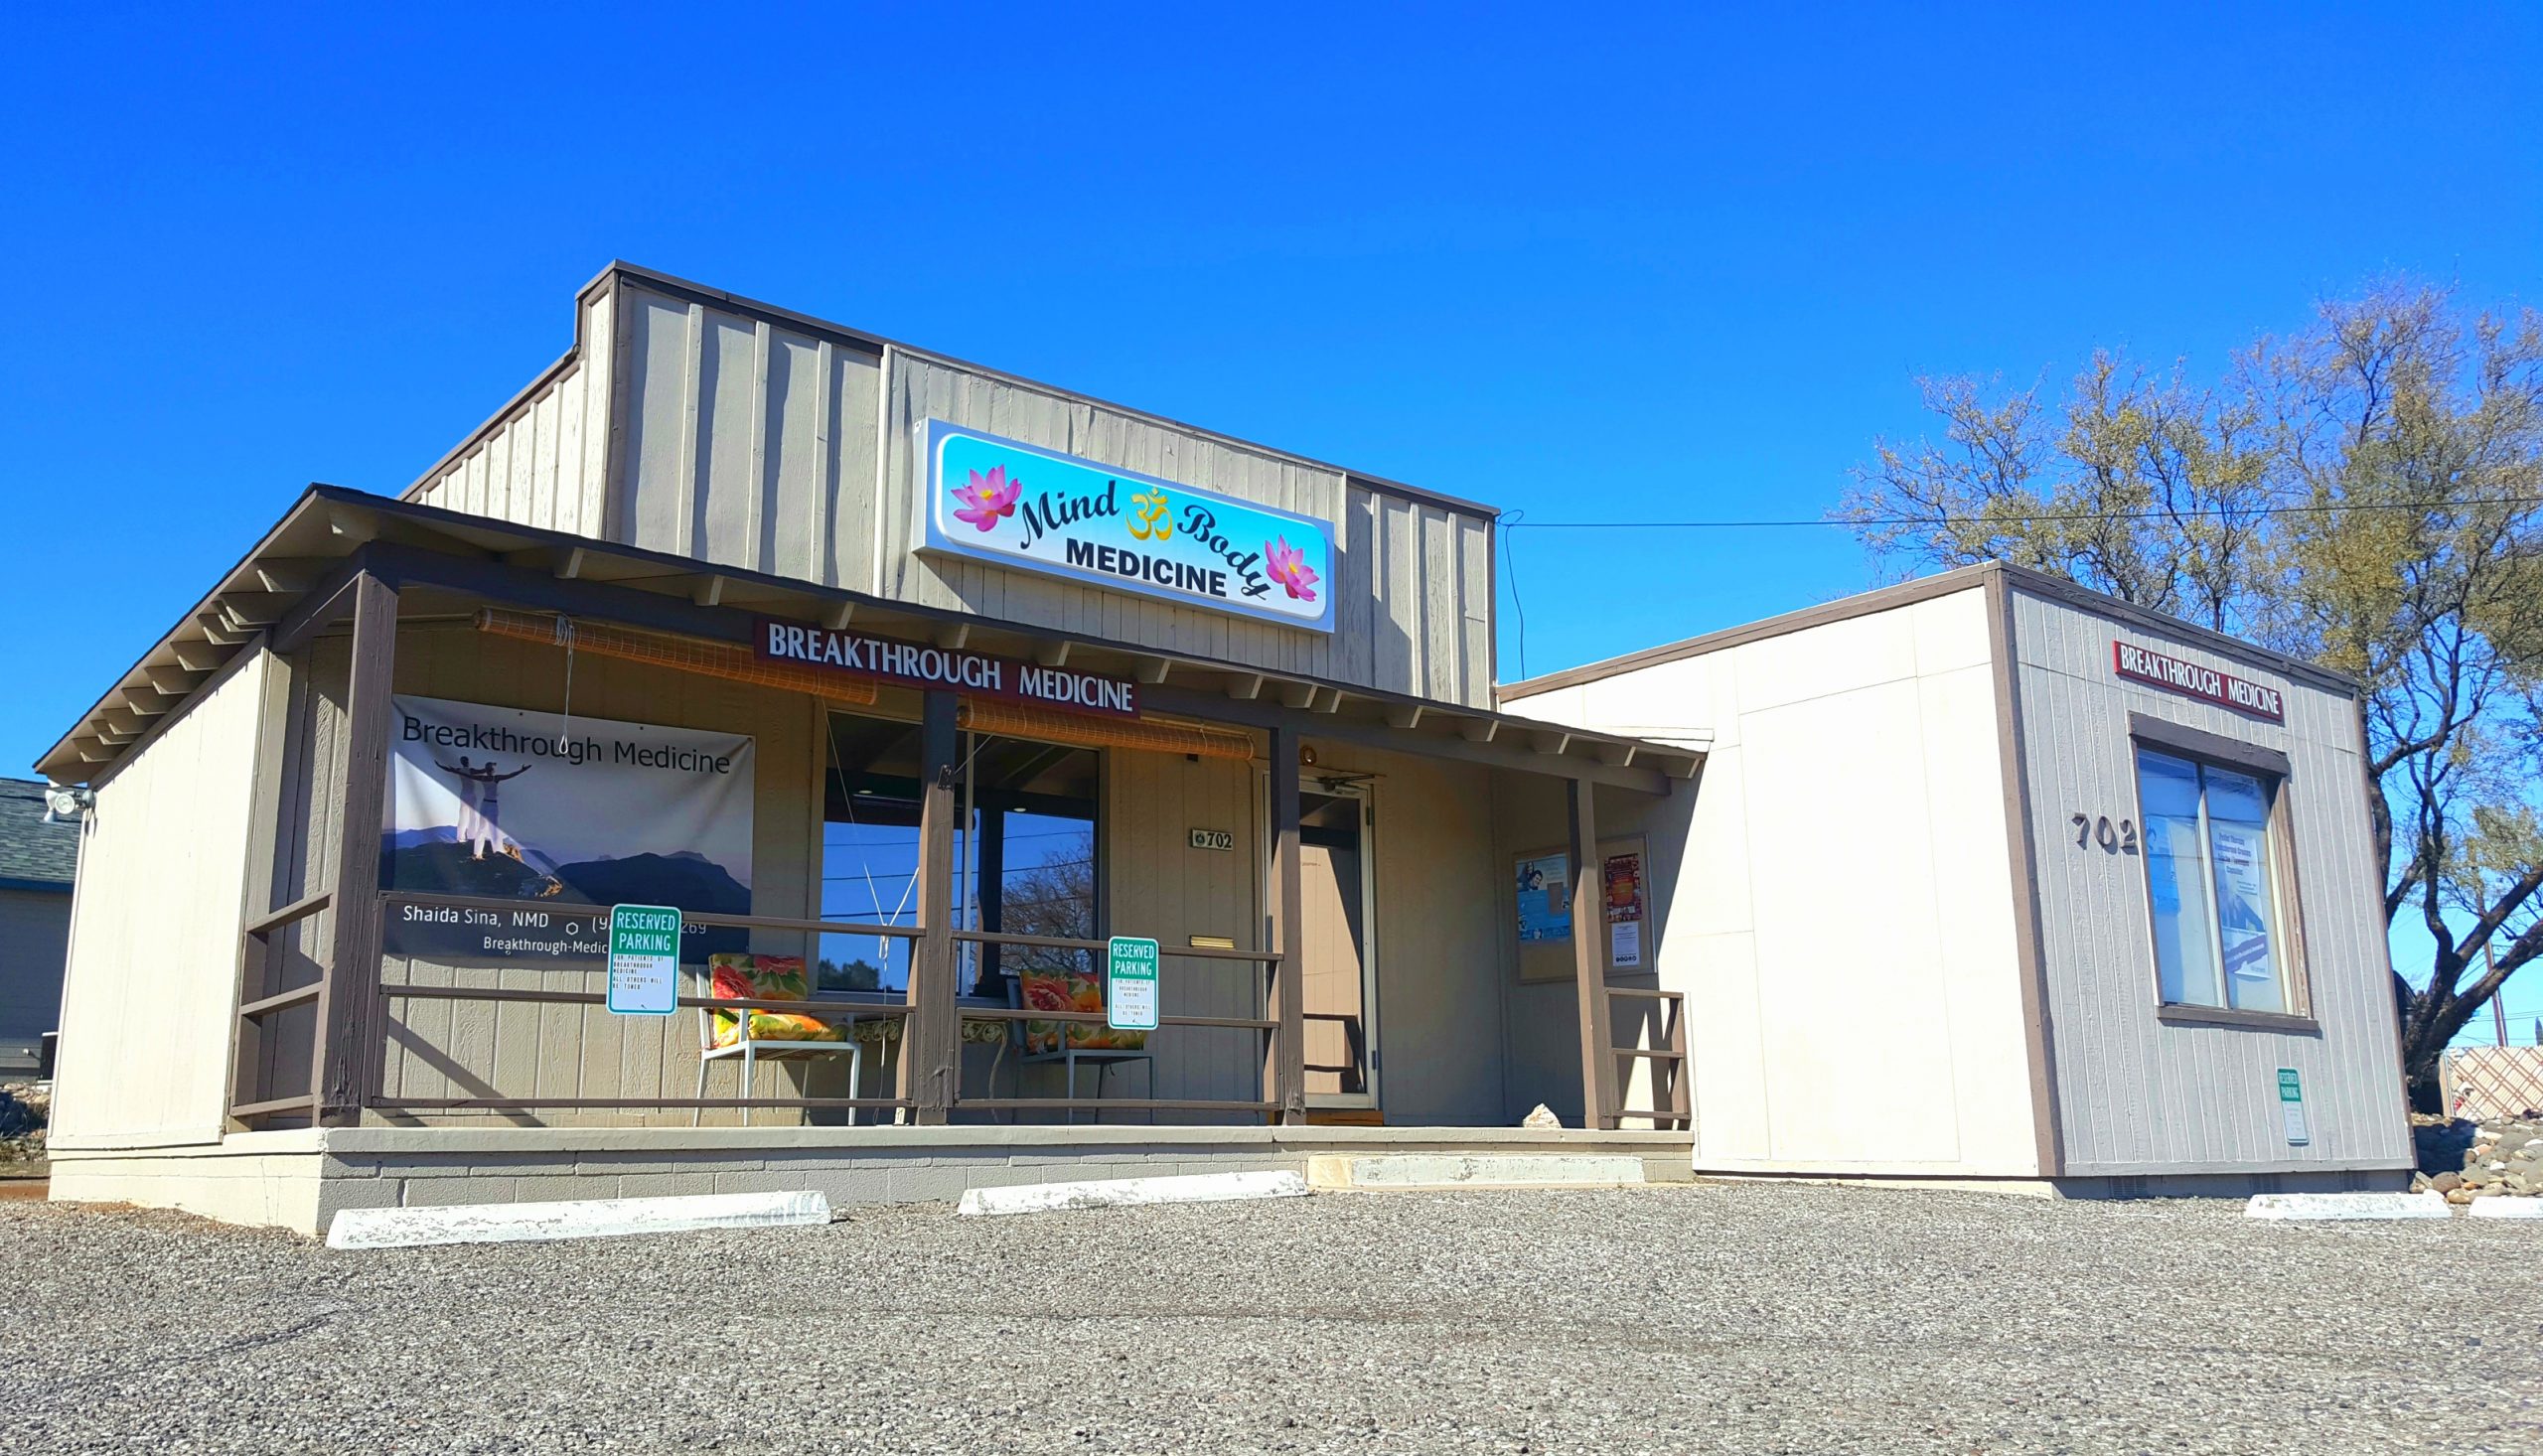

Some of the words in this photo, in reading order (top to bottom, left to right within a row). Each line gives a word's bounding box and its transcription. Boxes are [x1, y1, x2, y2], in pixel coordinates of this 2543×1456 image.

[1020, 480, 1121, 549] Mind
[1177, 505, 1272, 601] Body
[1066, 537, 1228, 597] MEDICINE
[768, 622, 1001, 690] BREAKTHROUGH
[1018, 665, 1133, 712] MEDICINE
[2120, 645, 2222, 697] BREAKTHROUGH
[2227, 678, 2280, 715] MEDICINE
[402, 716, 602, 765] Breakthrough
[614, 740, 731, 775] Medicine
[1207, 832, 1232, 848] 702
[2071, 812, 2137, 848] 702
[402, 905, 459, 924] Shaida
[464, 909, 502, 928] Sina,
[513, 912, 549, 928] NMD
[616, 912, 675, 932] RESERVED
[618, 932, 672, 951] PARKING
[1113, 943, 1155, 959] RESERVED
[1115, 959, 1152, 976] PARKING
